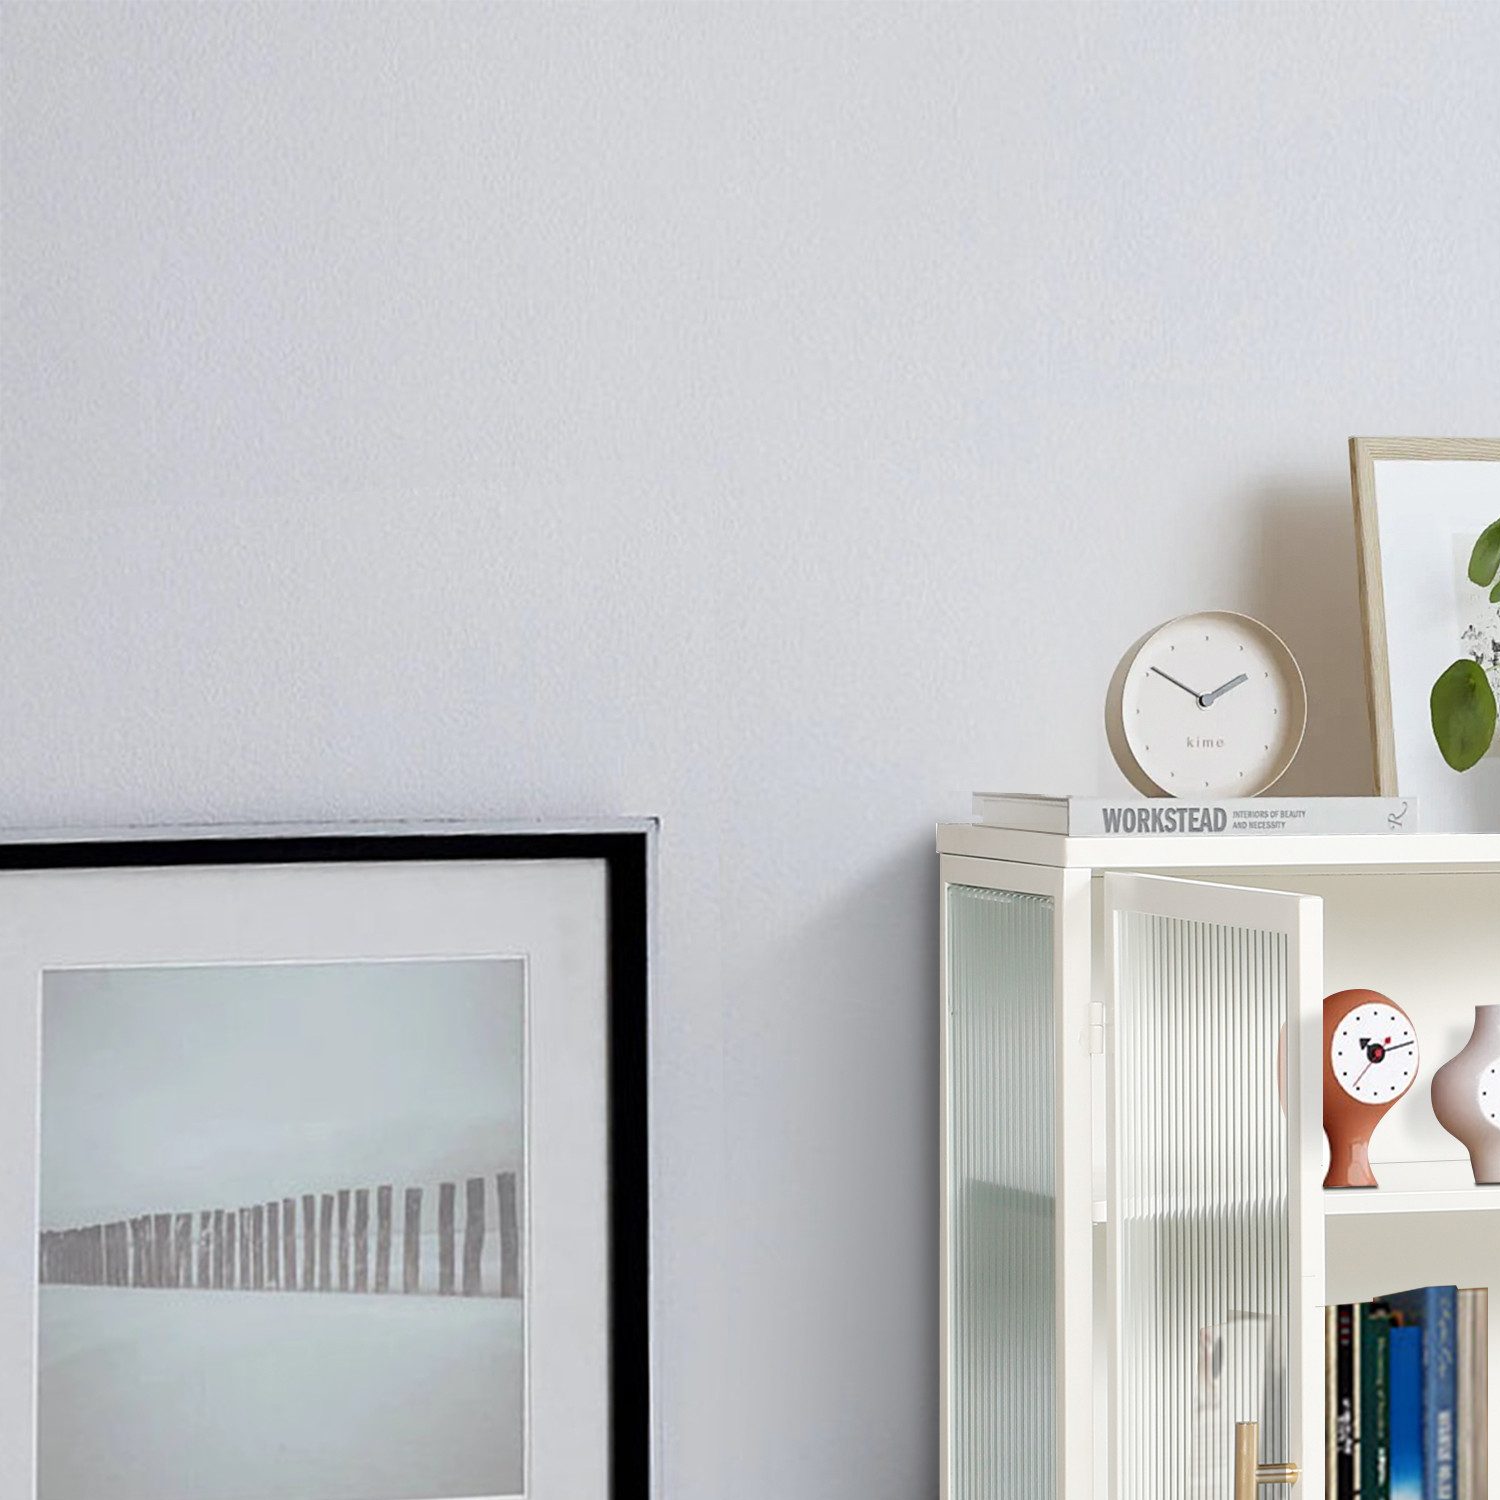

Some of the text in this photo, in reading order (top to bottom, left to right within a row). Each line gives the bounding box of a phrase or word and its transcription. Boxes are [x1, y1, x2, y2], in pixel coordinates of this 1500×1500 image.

[1186, 736, 1225, 748] kime
[1232, 810, 1306, 819] INTERIORS OF BEAUTY
[1102, 807, 1228, 833] WORKSTEAD
[1232, 821, 1286, 830] AND NECESSITY
